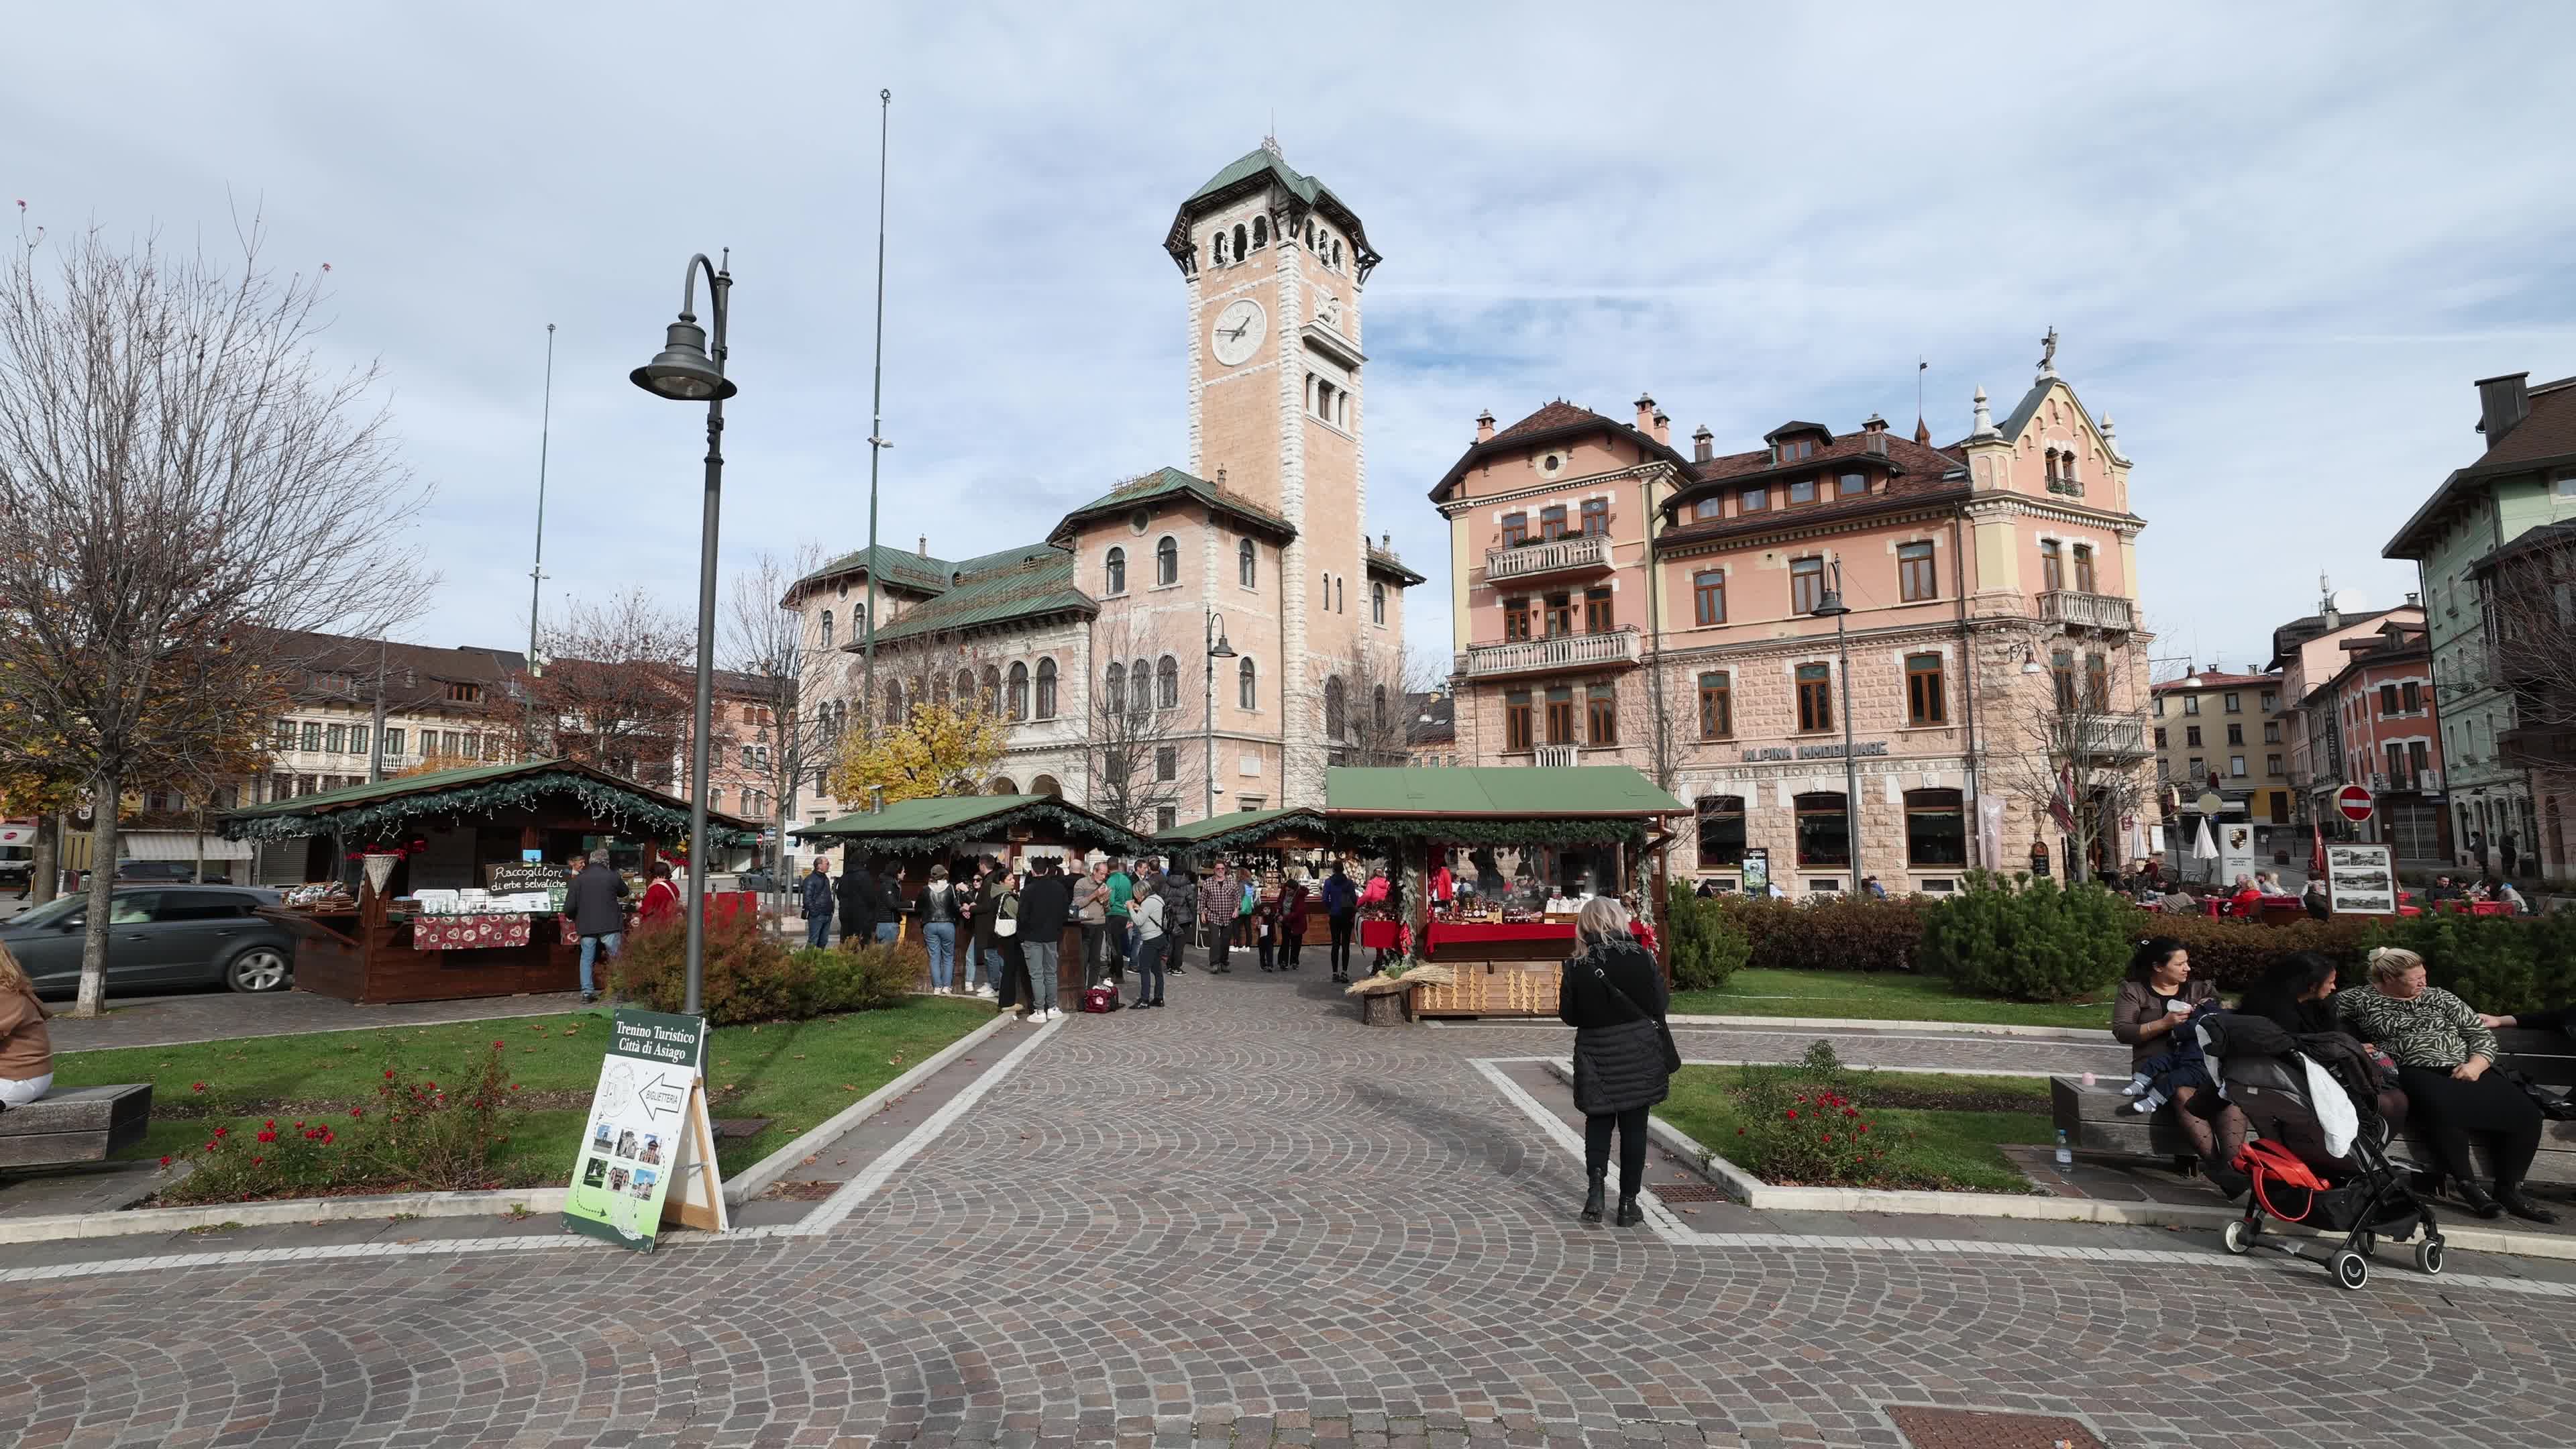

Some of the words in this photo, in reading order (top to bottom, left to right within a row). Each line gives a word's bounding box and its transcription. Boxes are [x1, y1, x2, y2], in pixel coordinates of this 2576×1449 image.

[1745, 747, 1792, 762] ALPINA
[494, 866, 563, 880] Raccoglitori
[491, 881, 502, 892] di
[503, 880, 521, 890] erbe
[525, 877, 567, 888] selvatiche
[616, 1020, 651, 1038] Trenino
[653, 1026, 695, 1044] Turistico
[619, 1037, 640, 1053] Città
[642, 1040, 653, 1054] di
[653, 1042, 686, 1063] Asiago
[645, 1089, 678, 1104] BIGLIETTERIA
